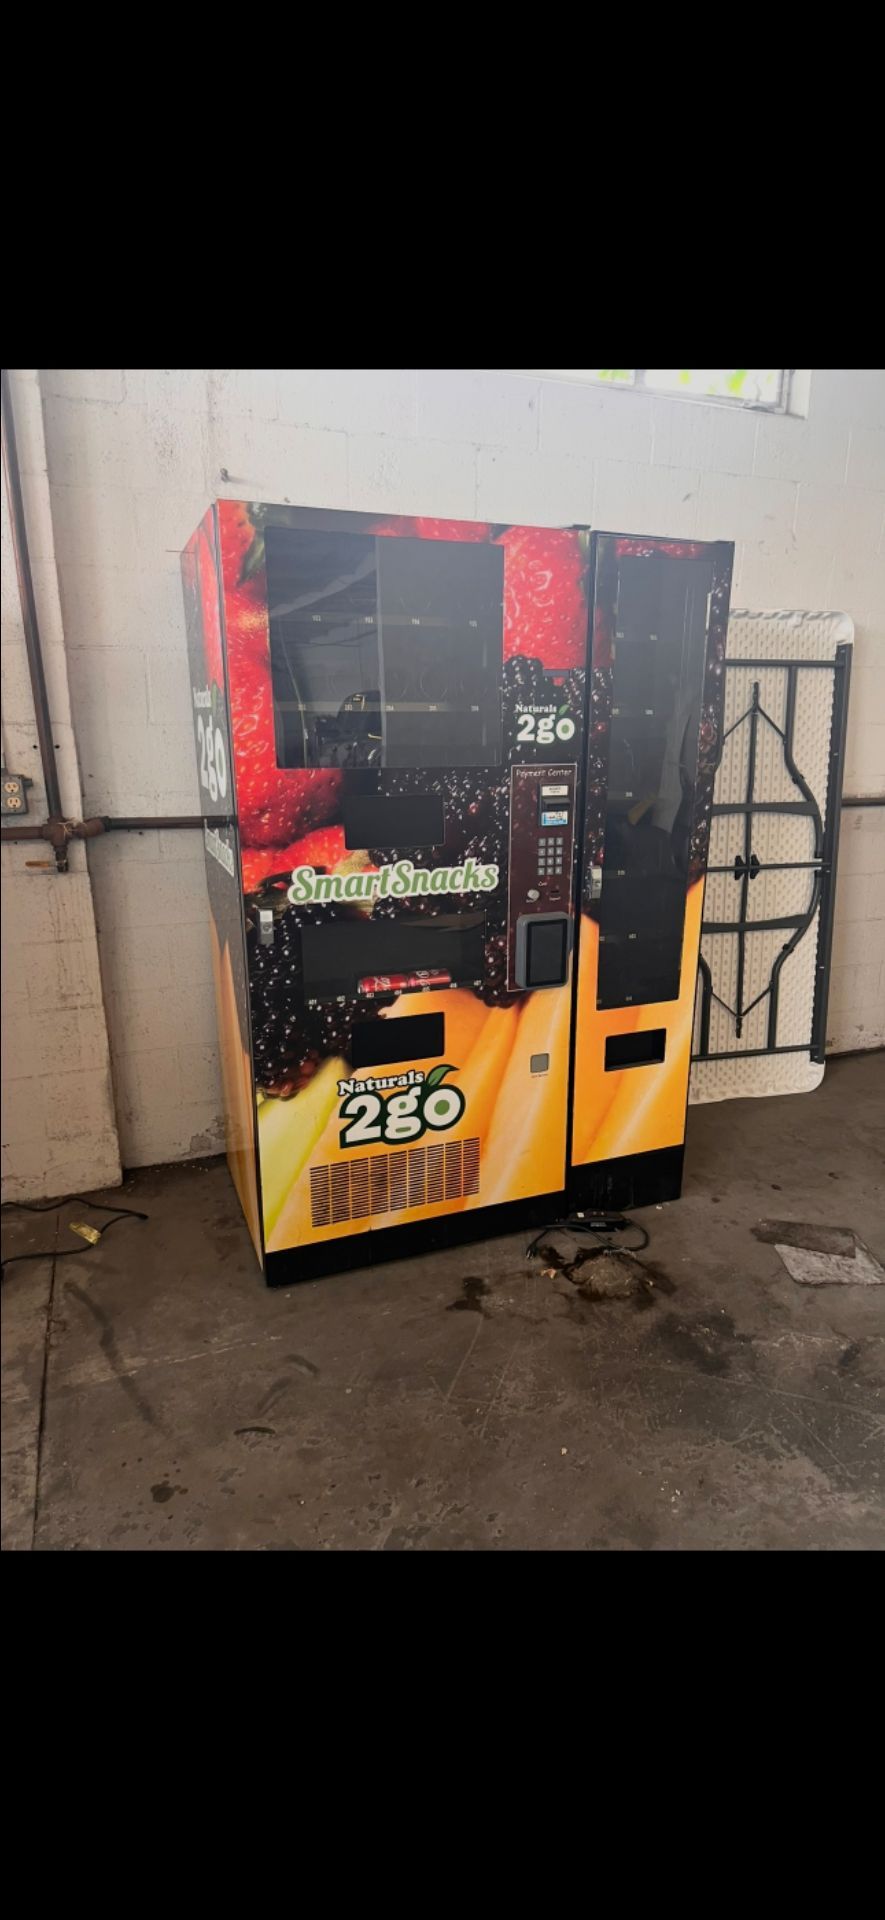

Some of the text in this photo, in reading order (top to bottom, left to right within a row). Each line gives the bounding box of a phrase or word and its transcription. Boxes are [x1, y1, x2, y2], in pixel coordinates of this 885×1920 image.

[514, 704, 557, 713] Naturals
[516, 713, 575, 744] 2go
[198, 714, 227, 802] 2go
[516, 768, 573, 779] Payment Center
[289, 858, 499, 904] SmartSnacks
[338, 1070, 425, 1096] Naturals
[343, 1085, 462, 1145] 2go
